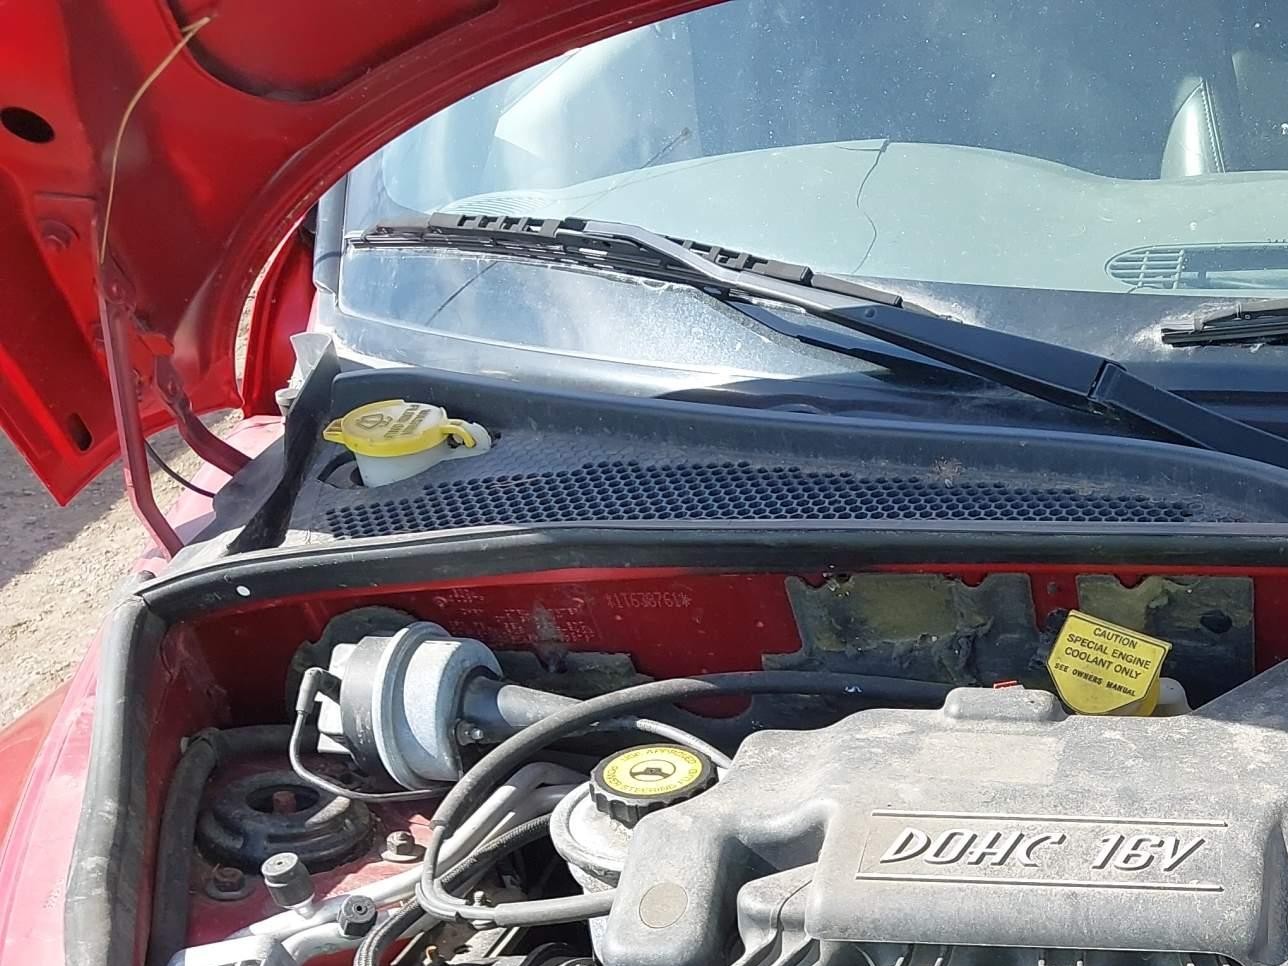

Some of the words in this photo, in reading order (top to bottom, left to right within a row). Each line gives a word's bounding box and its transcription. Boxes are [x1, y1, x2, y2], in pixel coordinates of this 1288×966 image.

[1066, 633, 1109, 655] SPECIAL
[1111, 648, 1152, 670] ENGINE
[1093, 627, 1138, 649] CAUTION
[1054, 662, 1069, 673] SEE
[1072, 669, 1103, 685] OWNERS
[1106, 680, 1136, 697] MANUAL
[1064, 646, 1112, 671] COOLANT
[1113, 663, 1142, 680] ONLY
[880, 827, 1068, 868] DOHC
[1091, 833, 1207, 873] 16V
